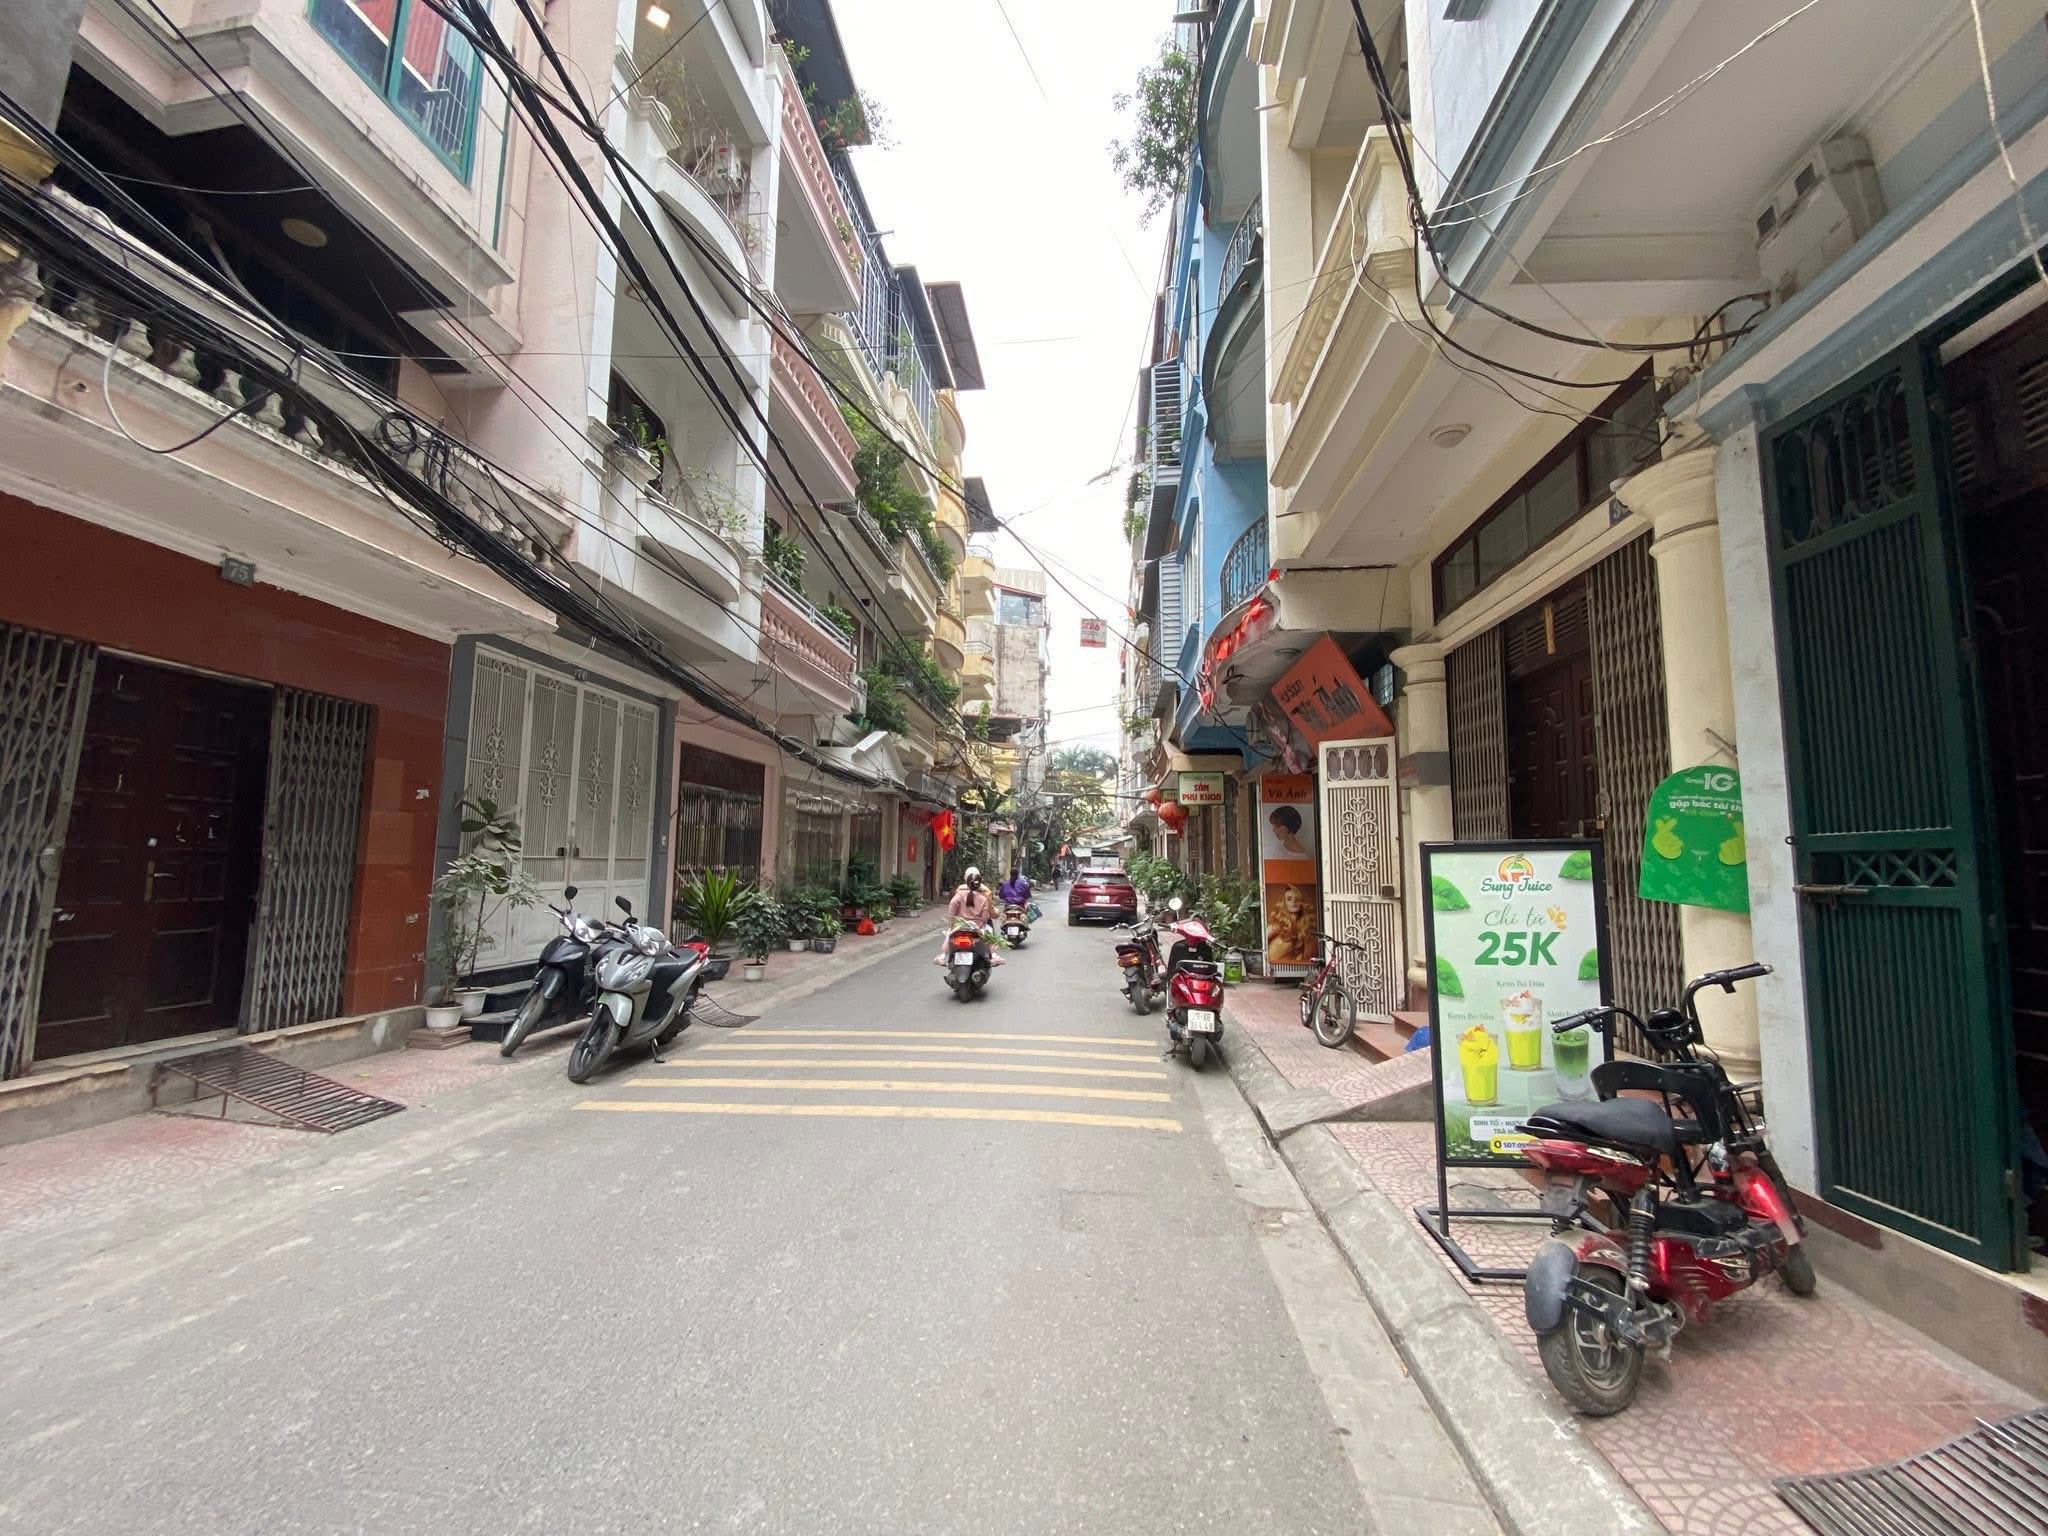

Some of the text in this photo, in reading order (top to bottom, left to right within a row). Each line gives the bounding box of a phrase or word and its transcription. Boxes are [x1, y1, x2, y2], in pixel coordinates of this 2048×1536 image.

[229, 561, 249, 582] 75
[1481, 877, 1553, 900] Sung Juice
[1474, 931, 1561, 966] 25K
